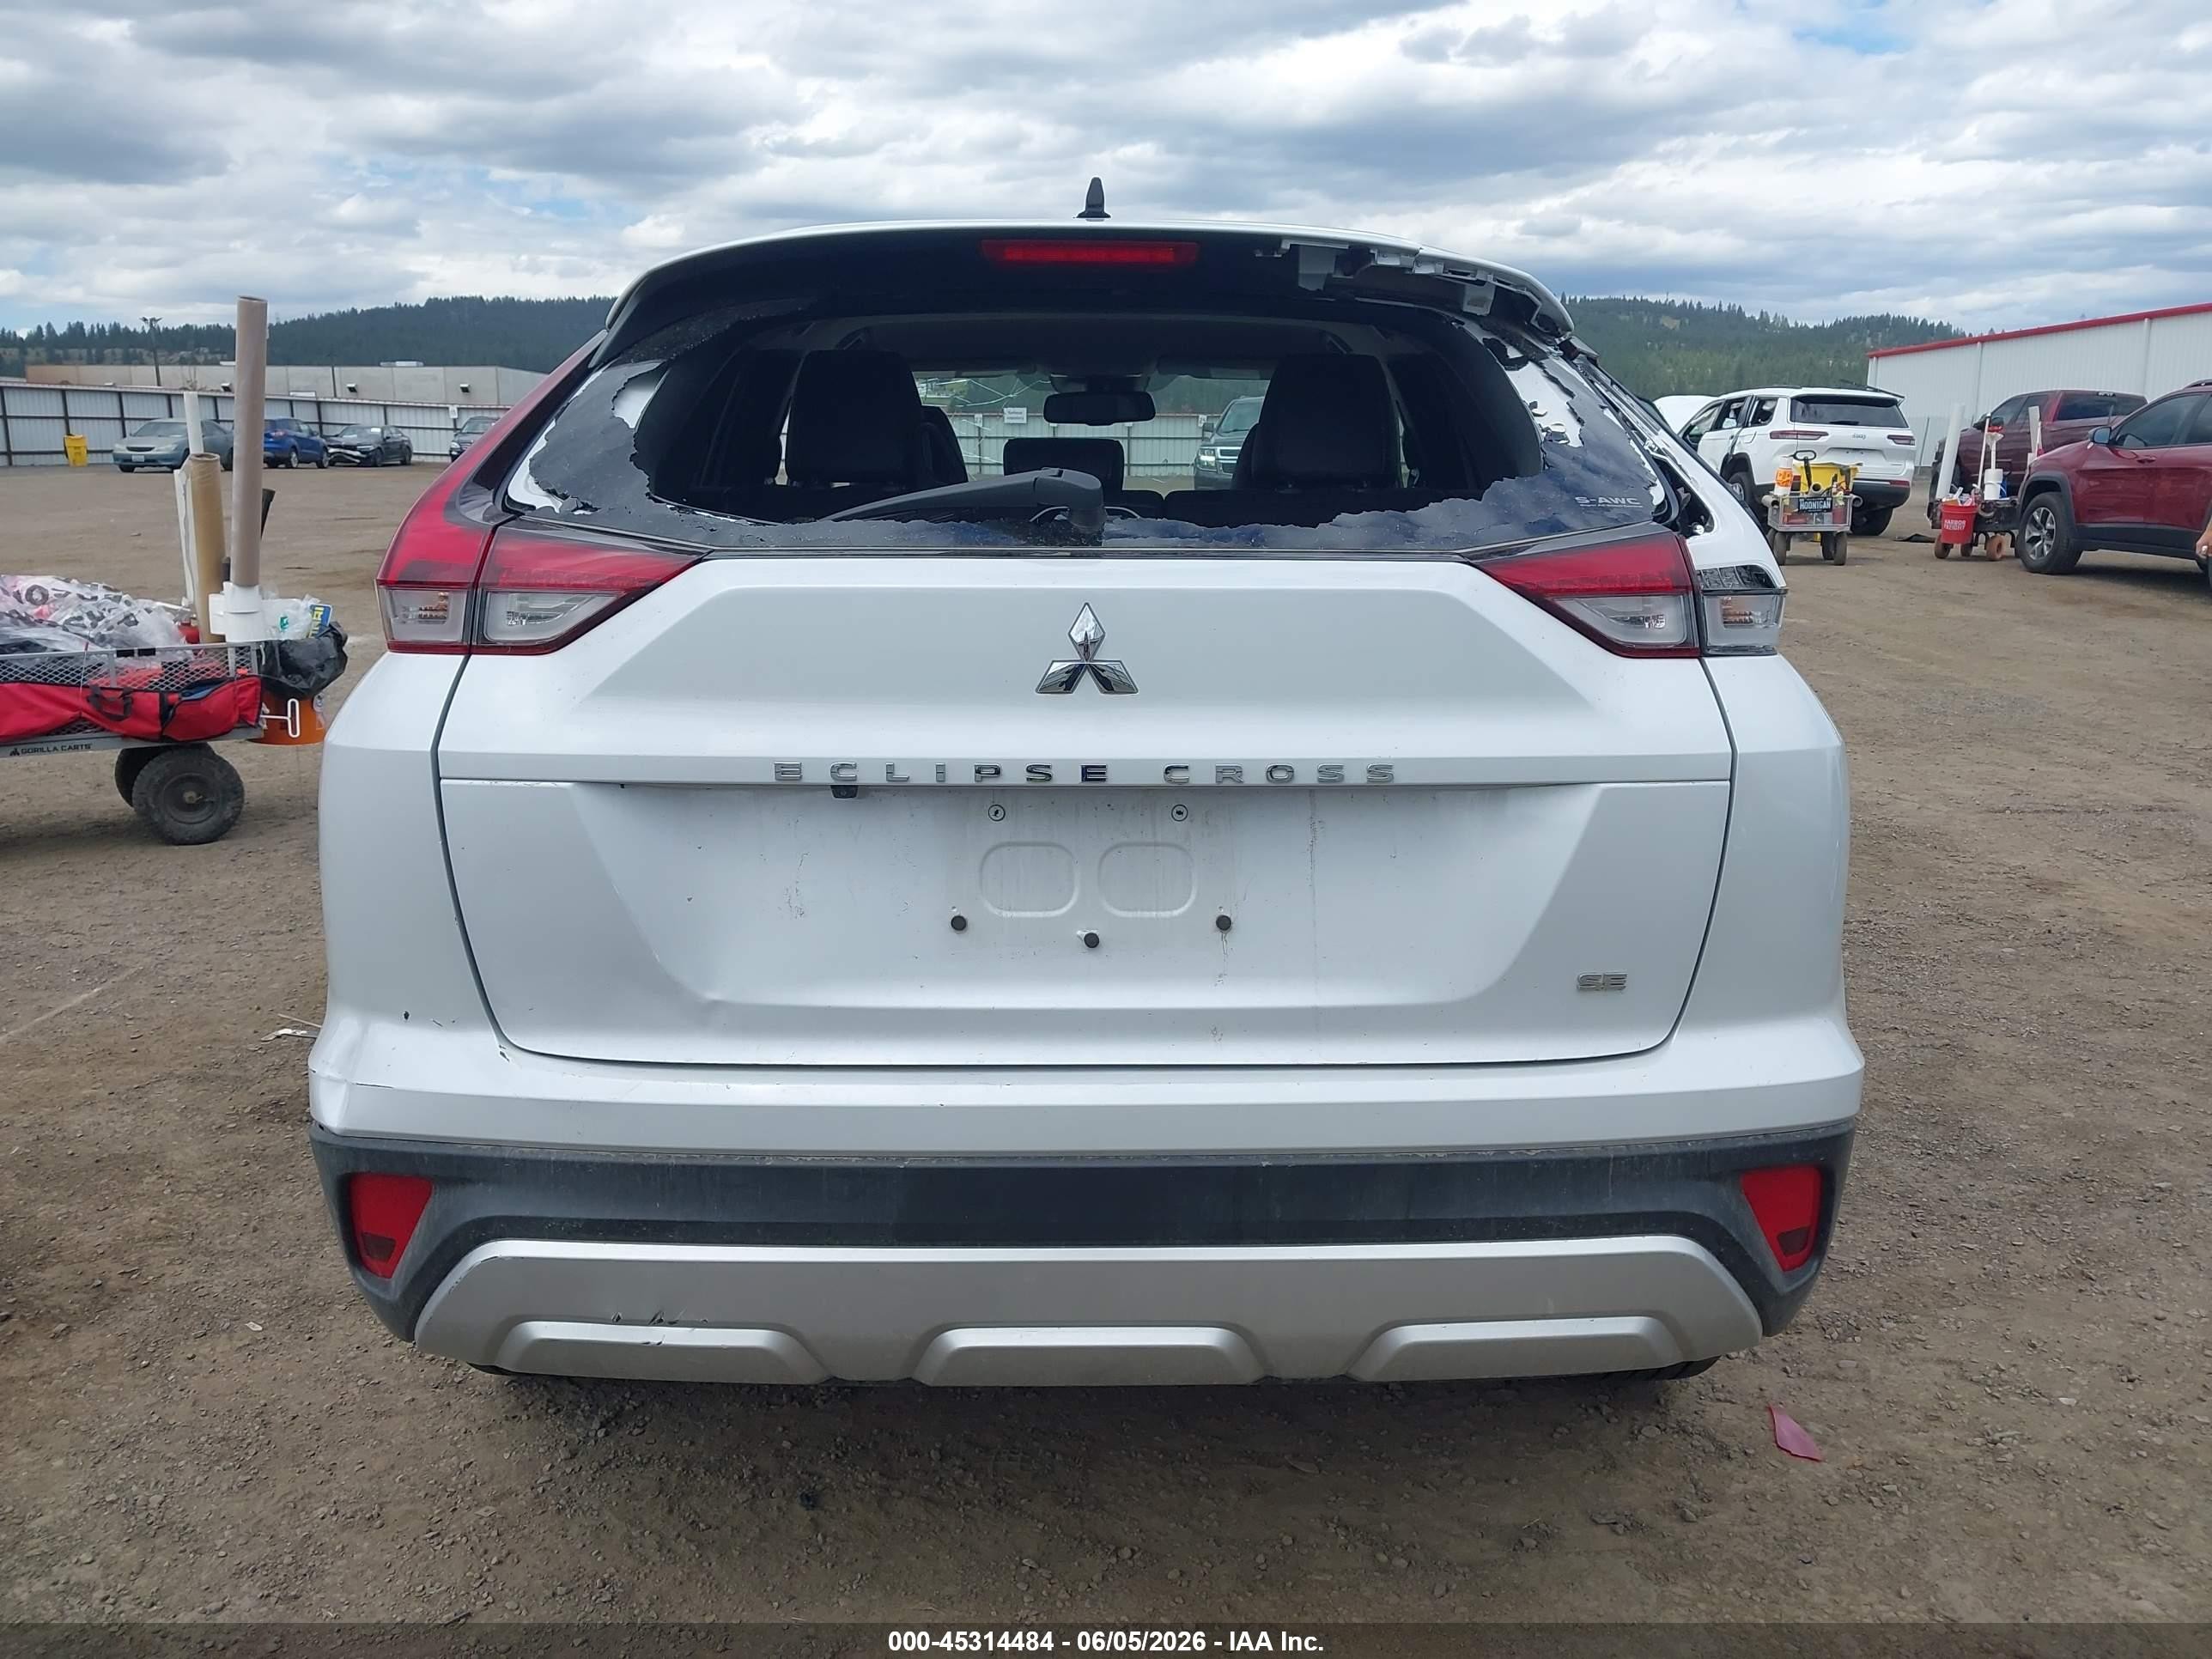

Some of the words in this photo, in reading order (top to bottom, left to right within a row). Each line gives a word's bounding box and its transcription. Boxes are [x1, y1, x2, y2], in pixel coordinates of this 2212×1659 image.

[1575, 496, 1641, 505] S-AWC
[1800, 501, 1831, 510] HOONIGAN
[21, 745, 59, 755] GORILLA
[61, 743, 91, 752] CARTS
[774, 762, 1109, 785] ECLIPSE
[1163, 763, 1395, 785] CROSS
[1577, 972, 1628, 991] SE
